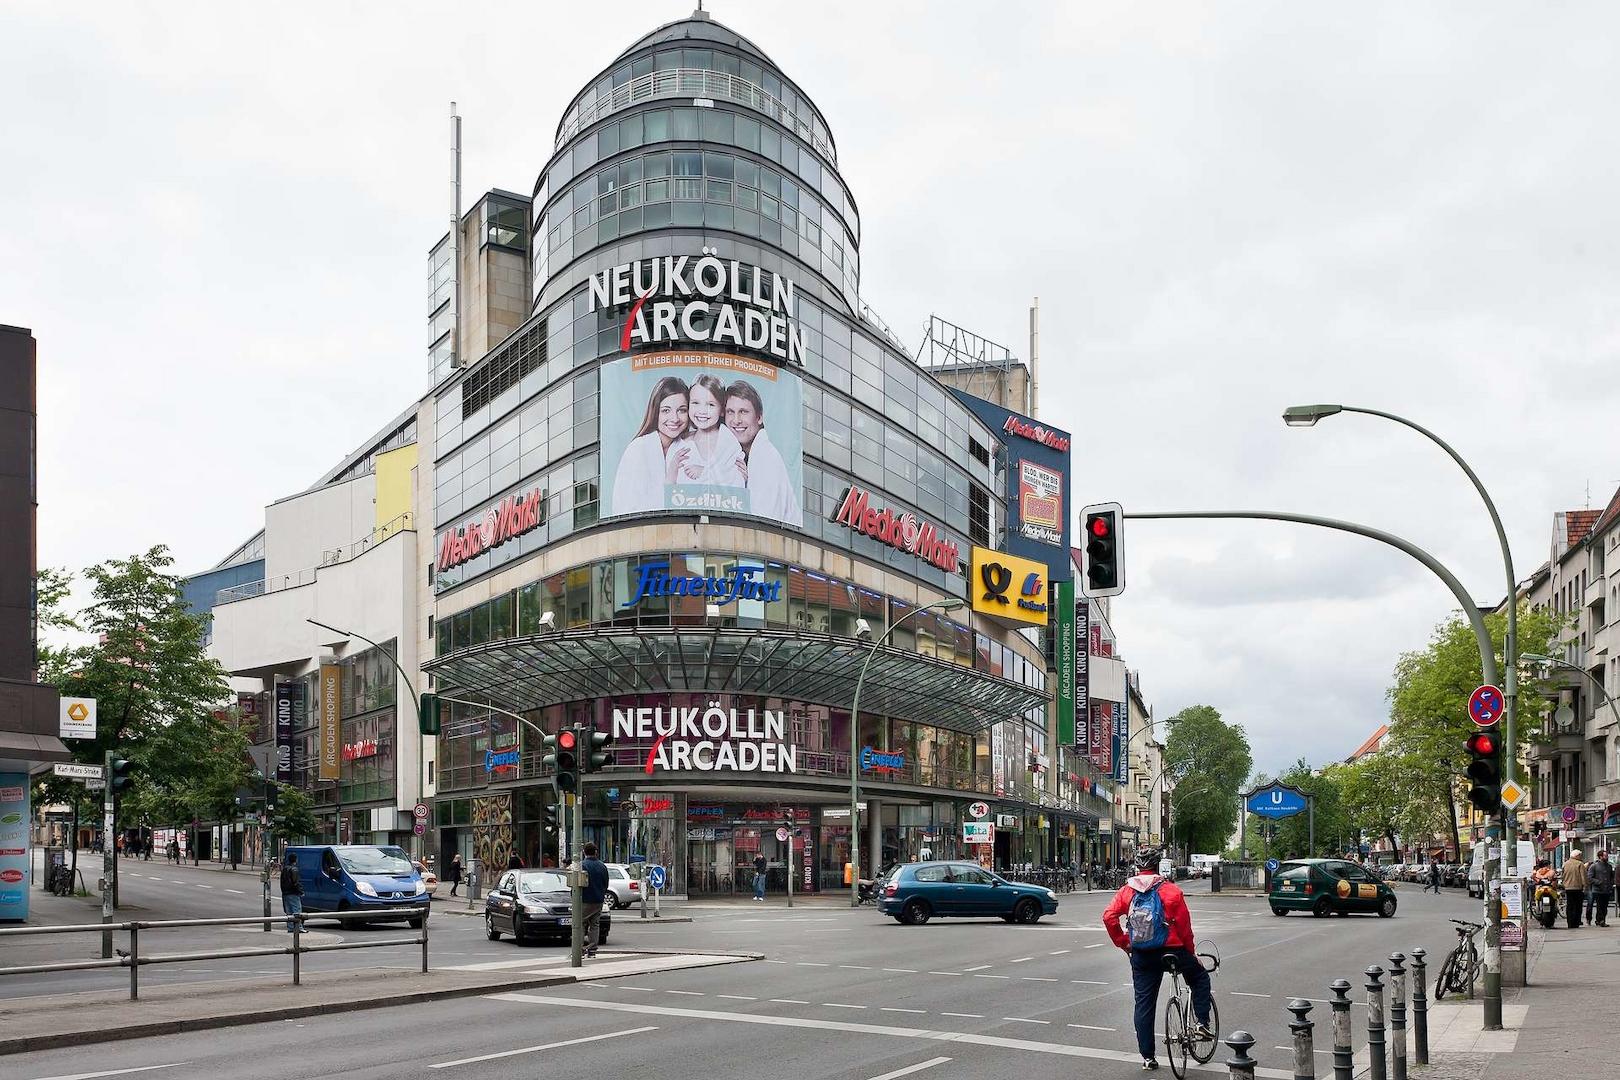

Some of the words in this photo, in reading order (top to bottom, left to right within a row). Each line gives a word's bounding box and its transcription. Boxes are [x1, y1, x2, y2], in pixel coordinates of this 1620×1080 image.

[588, 246, 794, 317] NEUKÖLLN
[621, 296, 807, 368] ARCADEN
[634, 357, 647, 369] MIT
[649, 355, 671, 366] LIEBE
[672, 354, 682, 364] IN
[684, 354, 701, 364] DER
[703, 353, 733, 367] TÜRKEI
[734, 359, 775, 378] PRODUZIERT
[1003, 415, 1036, 440] Media
[1043, 429, 1069, 452] Markt
[436, 527, 482, 573] Media
[488, 487, 541, 547] Markt
[836, 484, 902, 550] Media
[913, 521, 960, 574] Markt
[622, 561, 729, 607] Fitness
[715, 565, 783, 607] First
[1062, 622, 1070, 661] SHOPPING
[1076, 615, 1086, 639] KINO
[1061, 663, 1070, 699] ARCADEN
[1076, 650, 1086, 674] KINO
[279, 699, 290, 726] KINO
[326, 677, 335, 721] SHOPPING
[1076, 686, 1086, 709] KINO
[612, 700, 784, 740] NEUKÖLLN
[1076, 721, 1086, 745] KINO
[1092, 706, 1100, 748] Kaufland
[324, 722, 335, 767] ARCADEN
[646, 731, 797, 774] ARCADEN
[416, 806, 426, 815] 30
[1271, 791, 1283, 804] U
[804, 866, 812, 884] KINO
